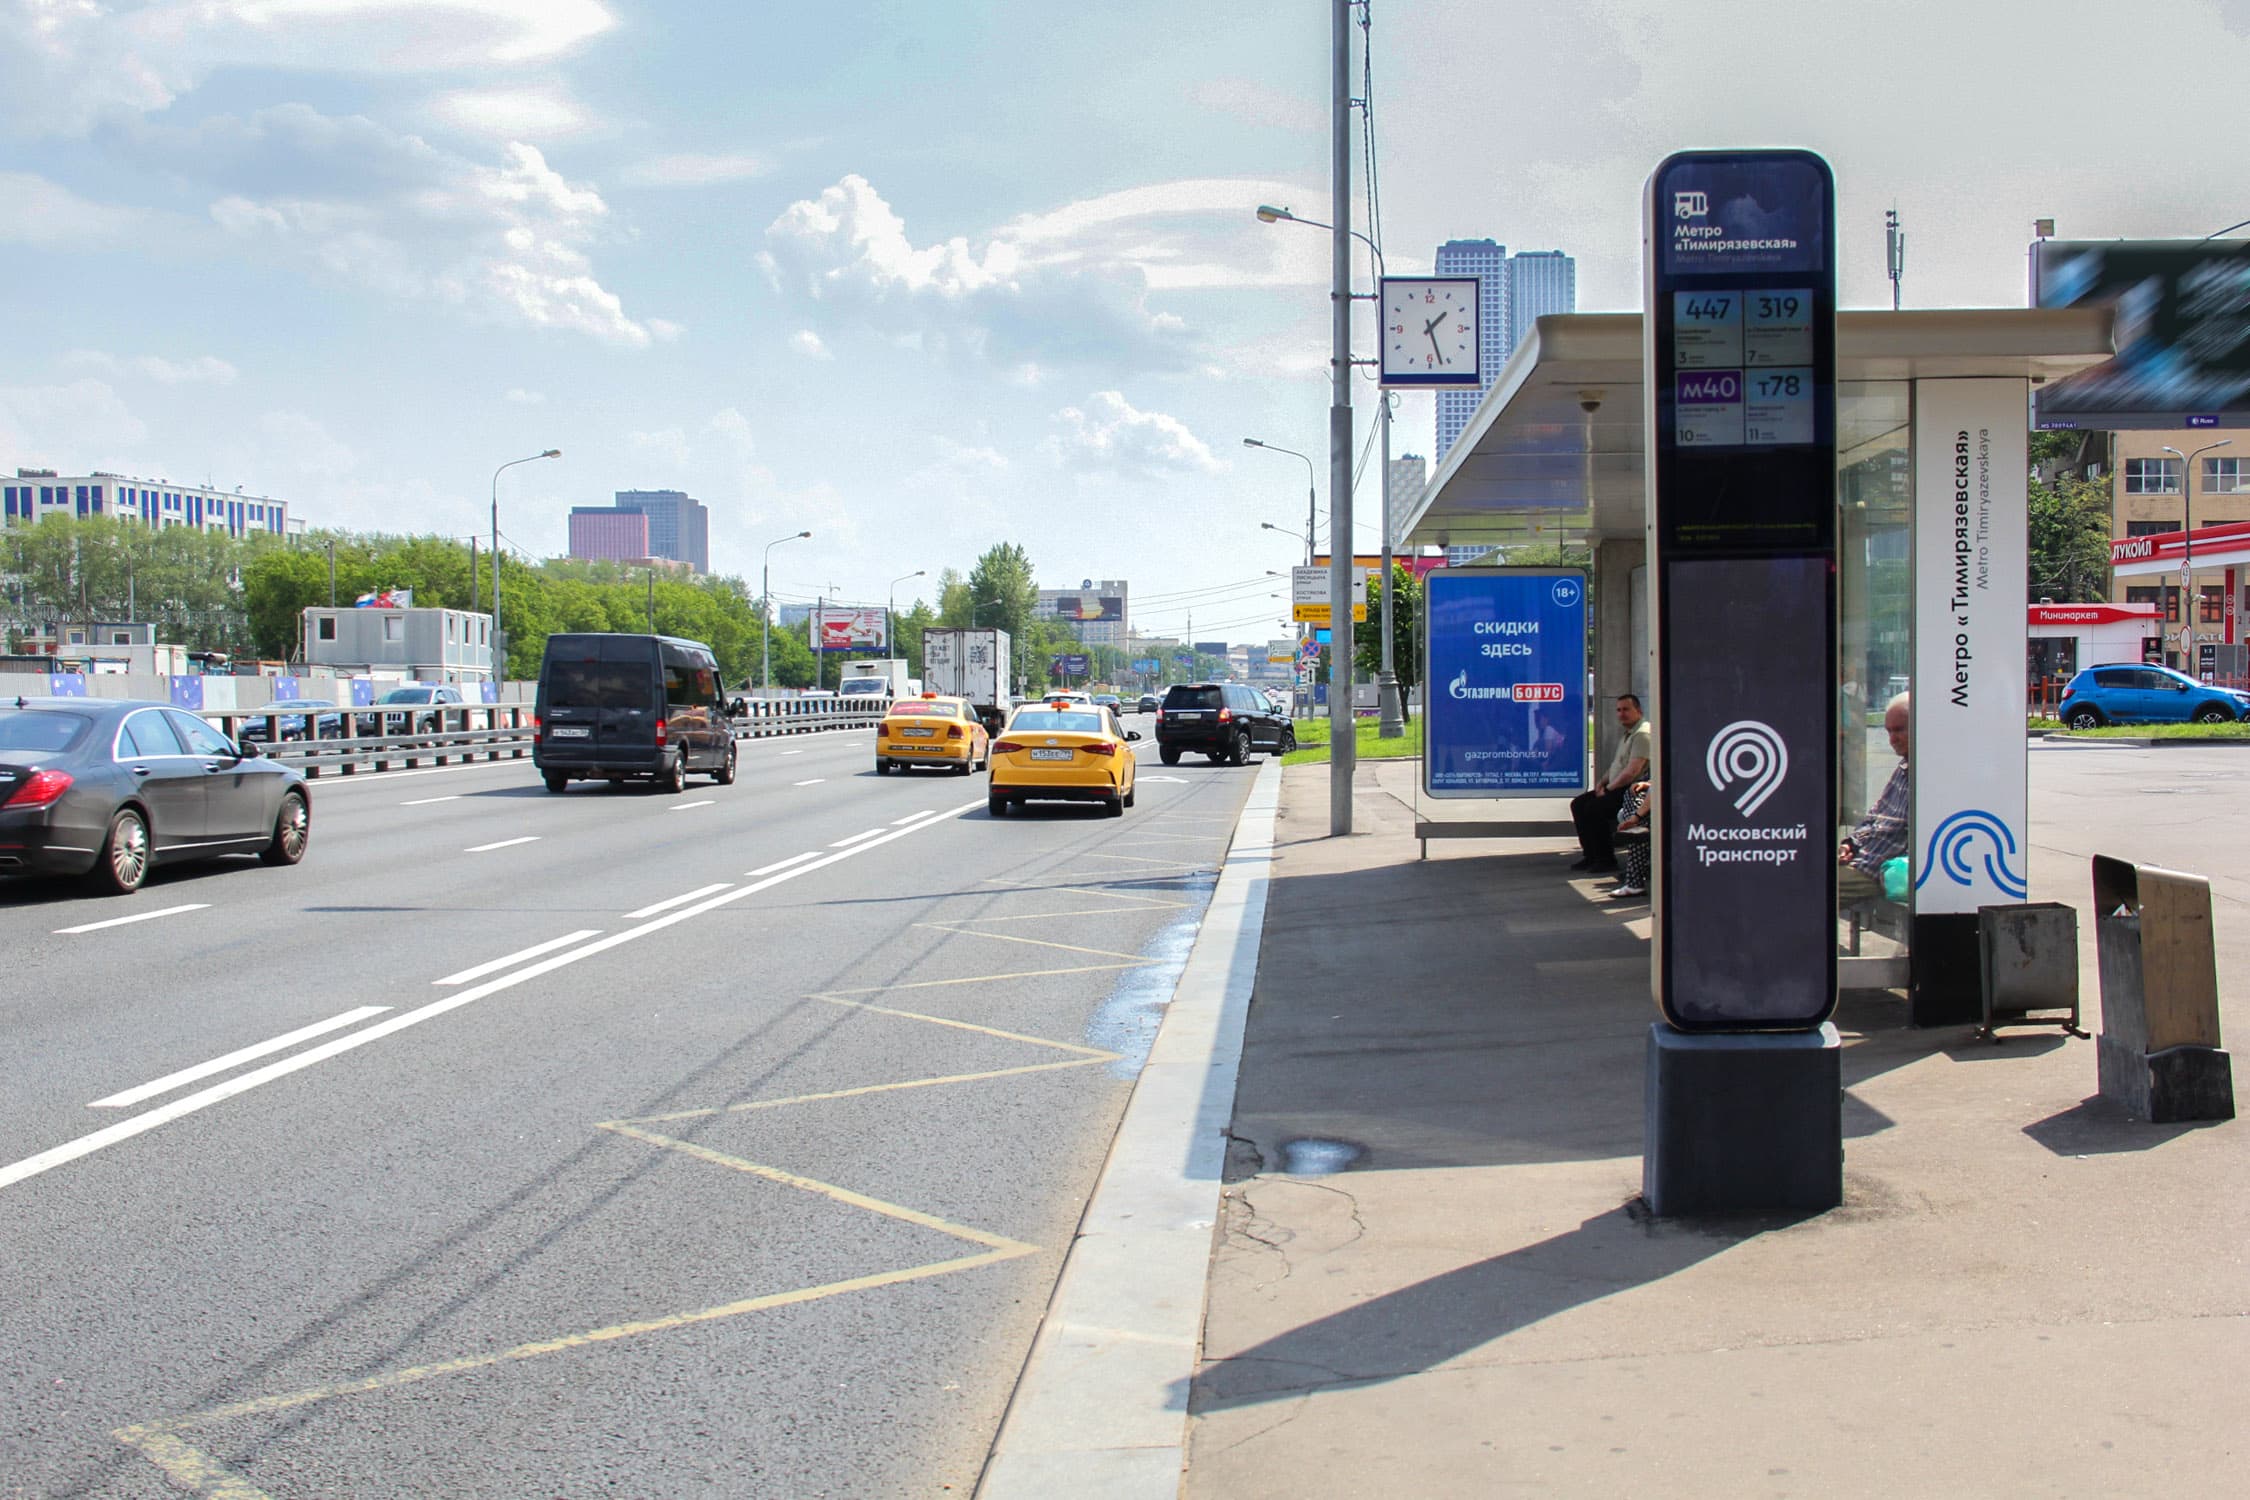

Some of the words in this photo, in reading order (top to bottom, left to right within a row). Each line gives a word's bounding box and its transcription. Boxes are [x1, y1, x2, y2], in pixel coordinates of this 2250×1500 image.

[1674, 225, 1723, 239] Метро
[1674, 238, 1797, 252] «Тимирязевская»
[1425, 295, 1435, 304] 12
[1686, 298, 1731, 319] 447
[1758, 297, 1798, 318] 319
[1396, 324, 1404, 334] 9
[1457, 324, 1464, 333] 3
[1426, 354, 1433, 363] 6
[1679, 351, 1687, 364] 3
[1748, 350, 1757, 362] 7
[1680, 430, 1694, 442] 10
[1749, 428, 1759, 441] 11
[1976, 428, 1992, 544] Timiryazevskaya
[2112, 538, 2152, 560] ЛУКОЙЛ
[1976, 548, 1989, 590] Metro
[1556, 588, 1575, 598] 18+
[2040, 611, 2099, 622] Минимаркет
[1474, 622, 1539, 636] СКИДКИ
[1481, 644, 1532, 658] ЗДЕСЬ
[1951, 633, 1973, 707] Метро
[1467, 687, 1510, 699] ГАЗПРОМ
[1515, 686, 1560, 698] БОНУС
[1465, 751, 1549, 761] gazprombonus.ru
[1688, 824, 1807, 841] Московский
[1696, 846, 1797, 867] Транспорт
